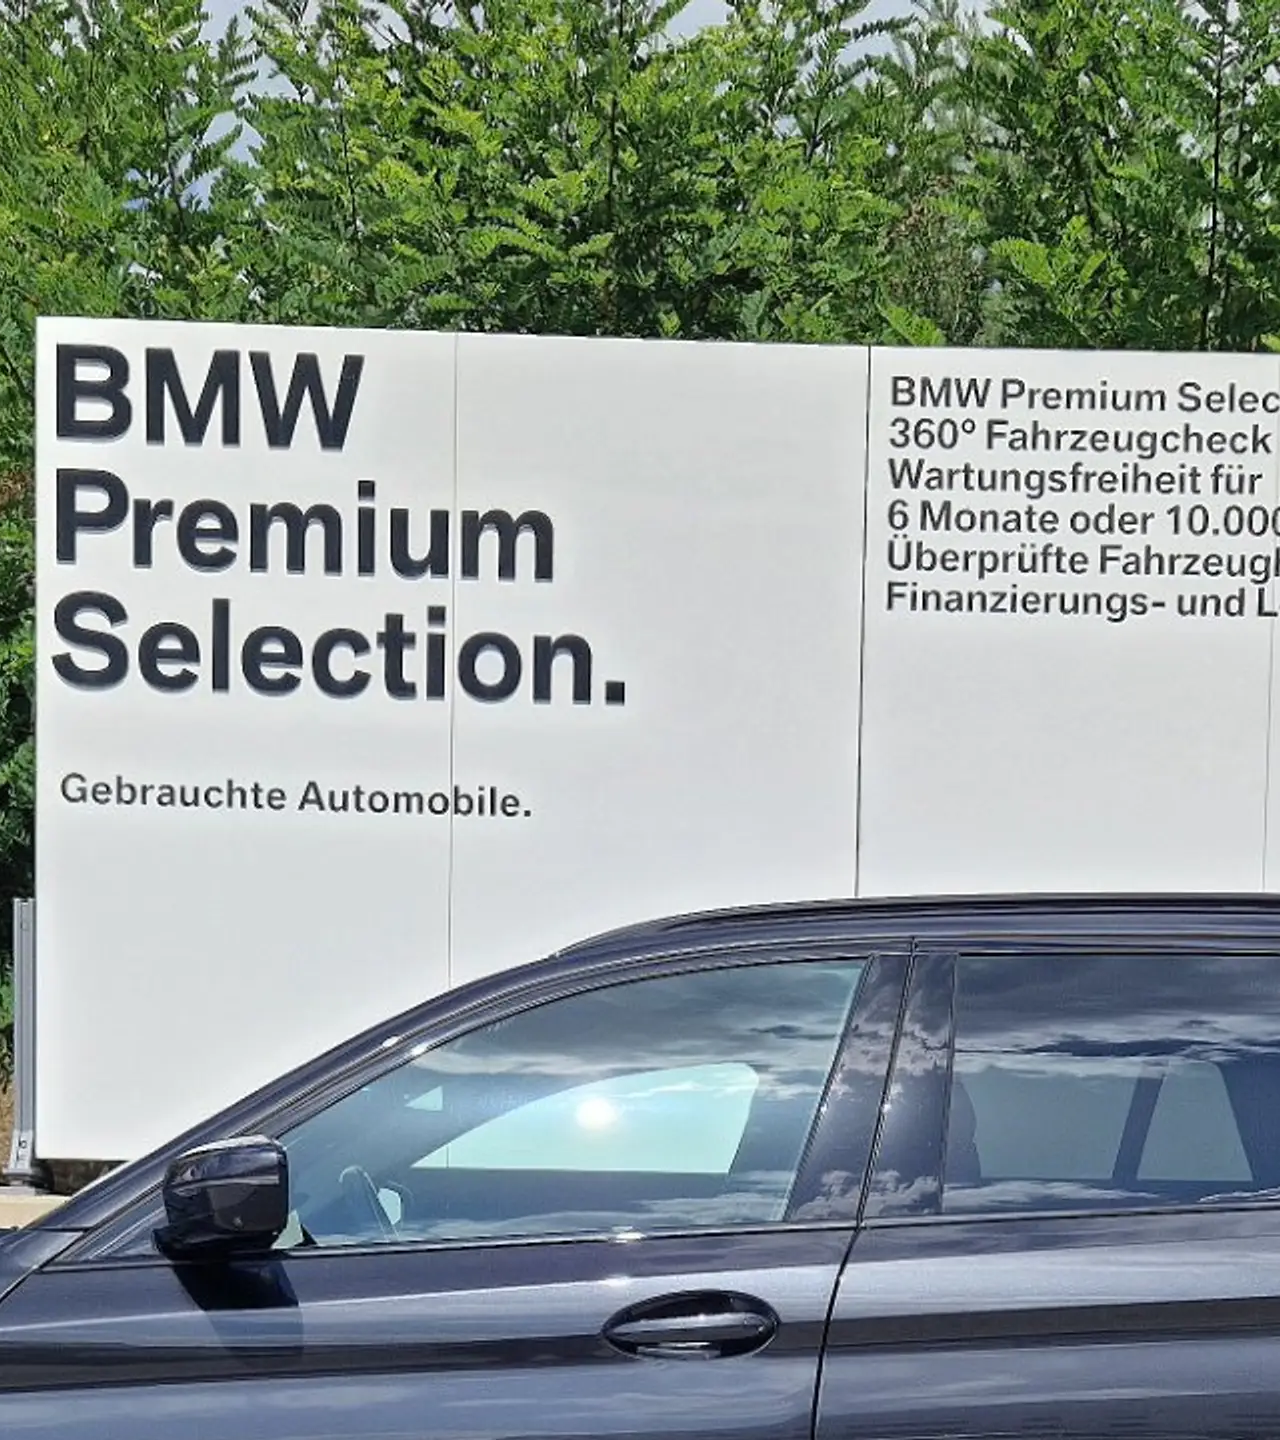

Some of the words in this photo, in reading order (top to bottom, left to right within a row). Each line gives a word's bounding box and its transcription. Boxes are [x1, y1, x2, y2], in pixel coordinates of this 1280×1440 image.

[54, 343, 366, 452] BMW
[890, 375, 992, 408] BMW
[1001, 378, 1167, 412] Premium
[987, 419, 1273, 460] Fahrzeugcheck
[888, 457, 1203, 500] Wartungsfreiheit
[1210, 463, 1264, 496] für
[54, 467, 555, 583] Premium
[887, 499, 910, 532] 6
[920, 500, 1061, 534] Monate
[1069, 503, 1156, 536] oder
[887, 533, 1090, 580] Überprüfte
[886, 580, 1167, 623] Finanzierungs-
[1177, 587, 1247, 618] und
[51, 590, 627, 707] Selection.
[60, 772, 287, 812] Gebrauchte
[298, 781, 533, 819] Automobile.
